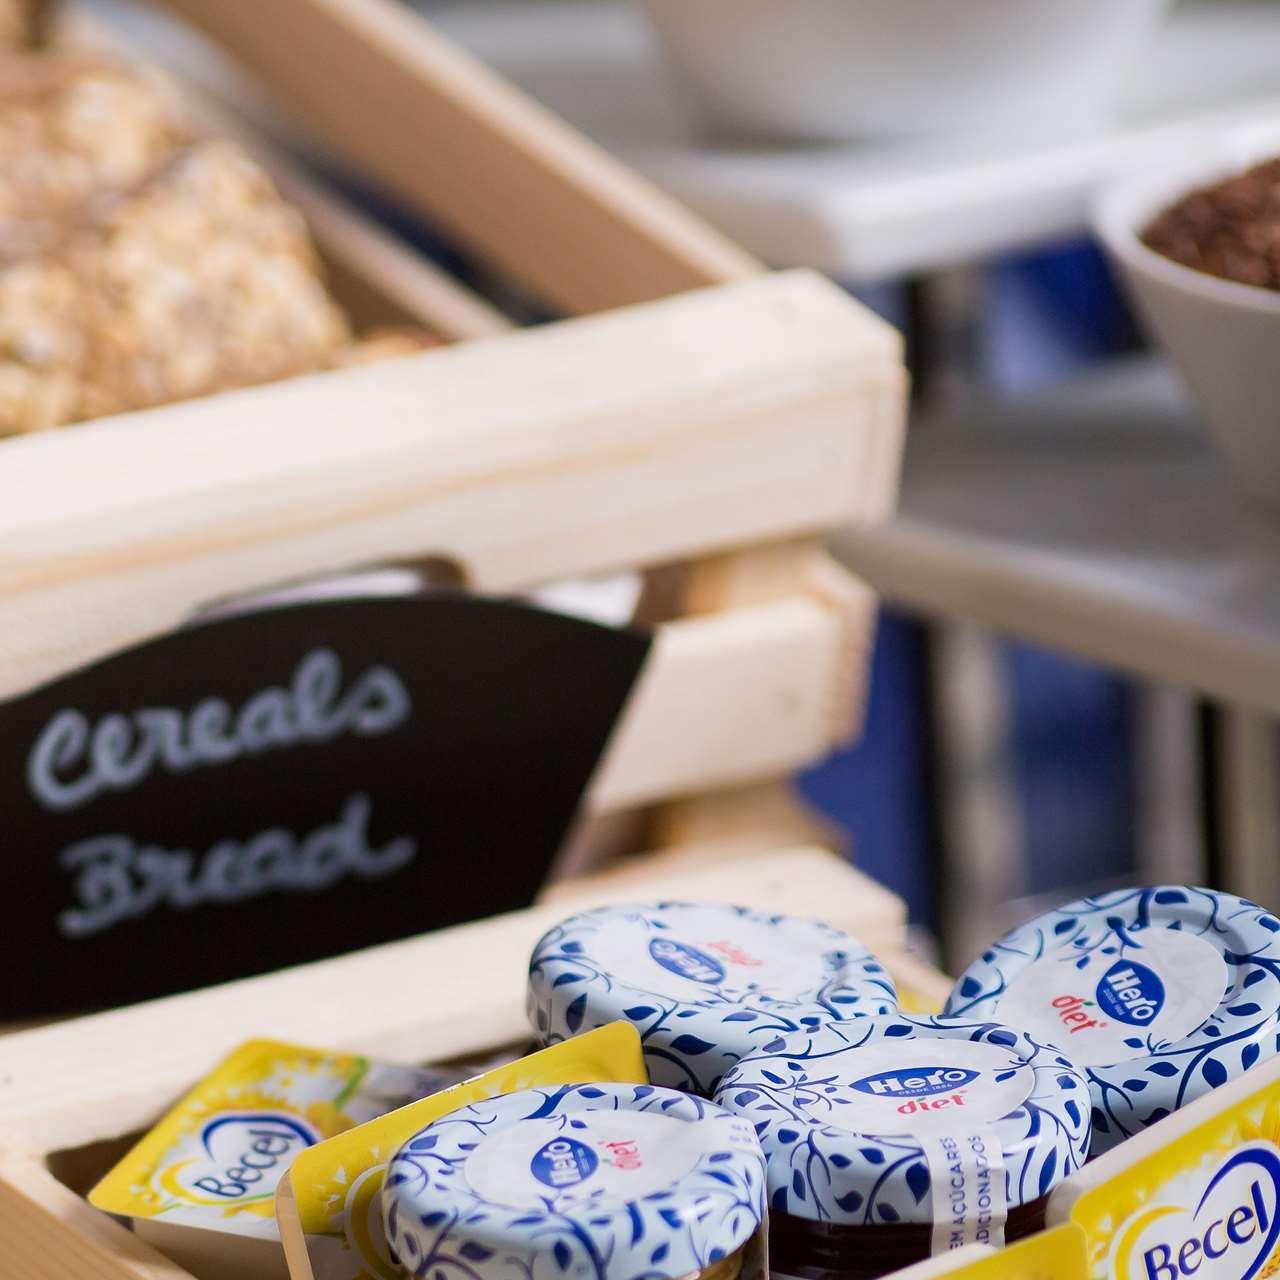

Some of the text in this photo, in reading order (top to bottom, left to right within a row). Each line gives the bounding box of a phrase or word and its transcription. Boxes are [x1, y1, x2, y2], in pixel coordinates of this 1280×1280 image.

[27, 648, 413, 808] Cereals
[57, 795, 418, 940] Bread
[1106, 968, 1157, 1019] Hero
[867, 1069, 967, 1094] Hero
[897, 1094, 965, 1114] diet
[193, 1129, 297, 1197] Becel
[968, 1136, 992, 1245] DICIONADOS
